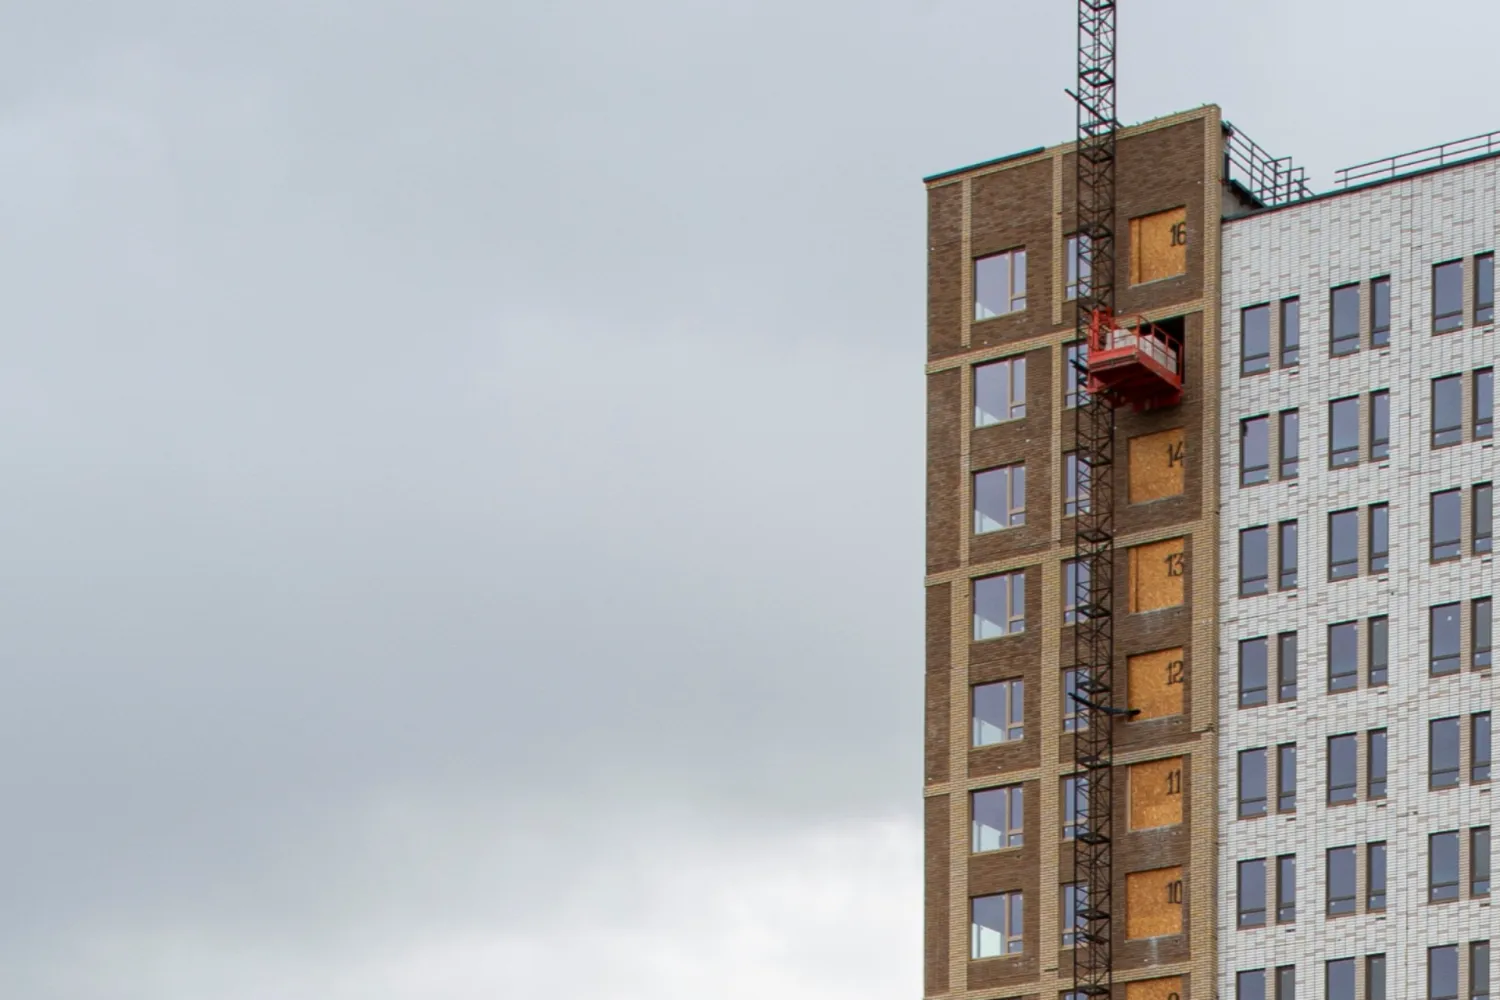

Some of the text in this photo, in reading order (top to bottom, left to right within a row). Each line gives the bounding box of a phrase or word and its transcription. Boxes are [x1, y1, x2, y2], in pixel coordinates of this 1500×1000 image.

[1170, 221, 1187, 247] 16
[1167, 441, 1184, 468] 14
[1164, 552, 1184, 577] 13
[1165, 660, 1184, 686] 12
[1166, 769, 1181, 796] 11
[1166, 879, 1183, 905] 10
